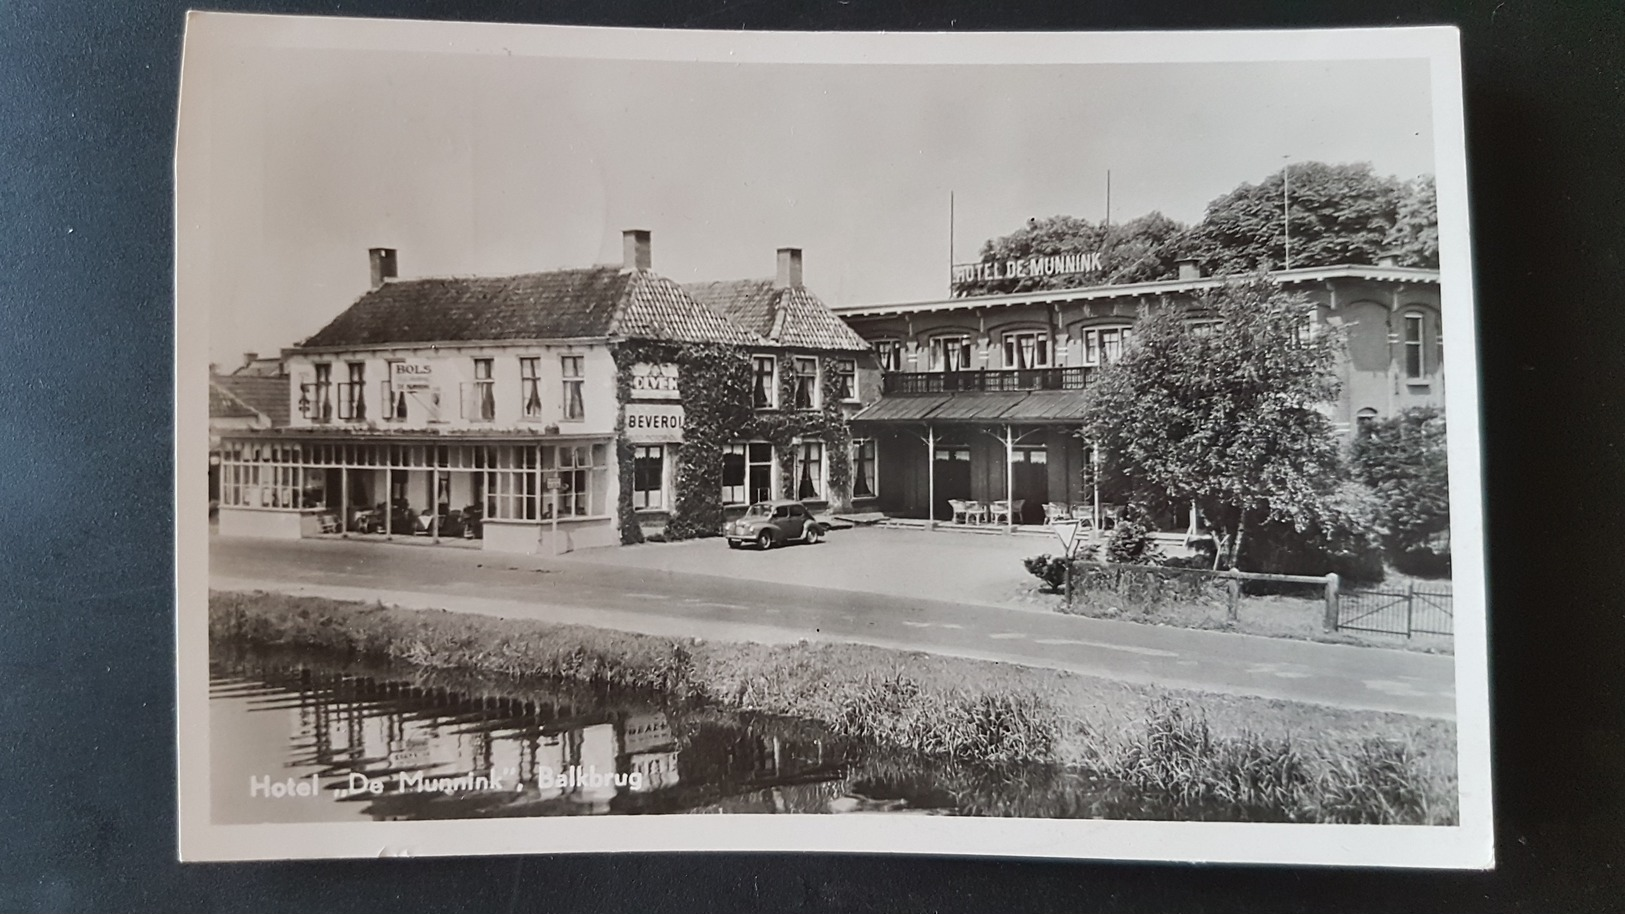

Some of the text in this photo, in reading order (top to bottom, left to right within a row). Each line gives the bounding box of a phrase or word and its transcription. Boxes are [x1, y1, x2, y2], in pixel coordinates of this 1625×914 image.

[954, 252, 1102, 283] HOTEL DE MUNNINK
[396, 364, 432, 375] BOLS
